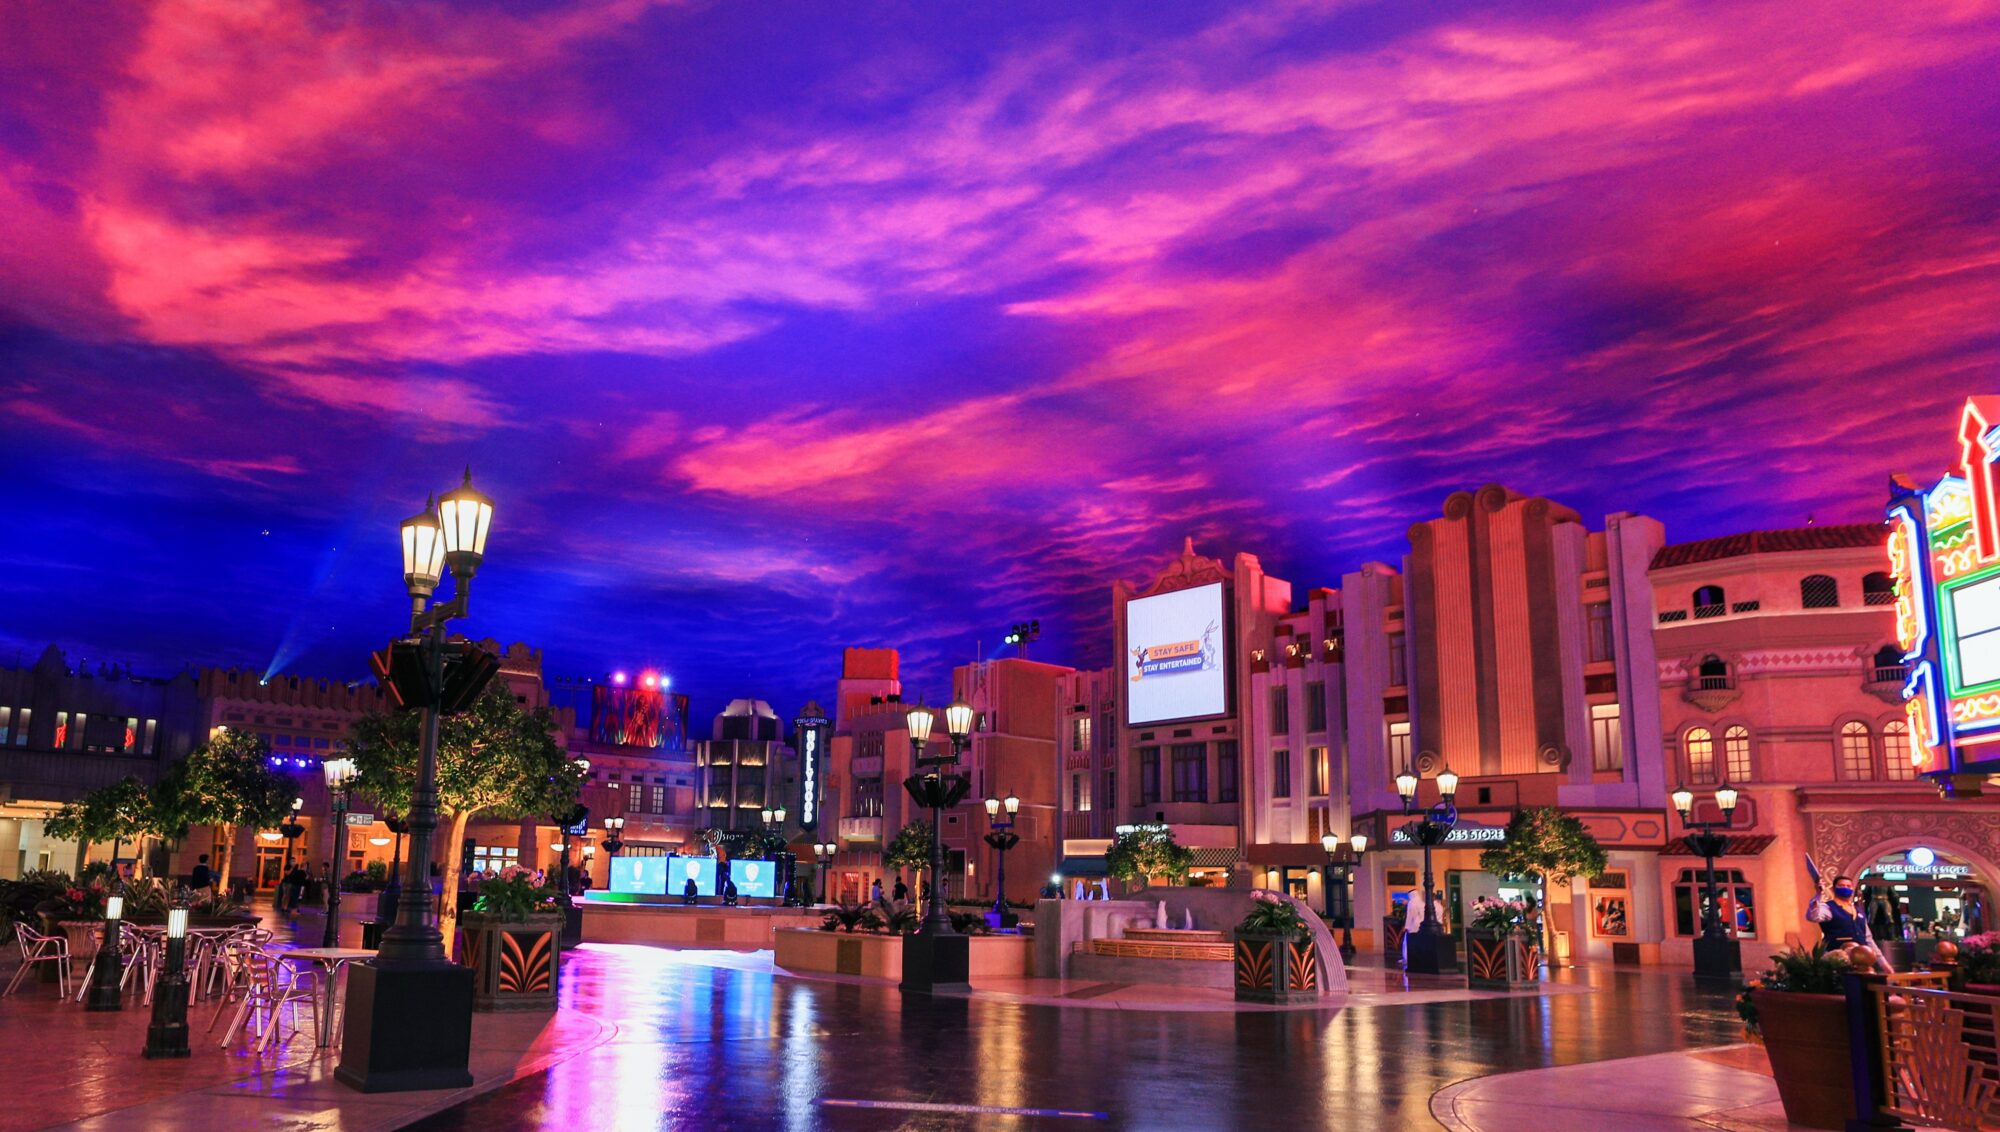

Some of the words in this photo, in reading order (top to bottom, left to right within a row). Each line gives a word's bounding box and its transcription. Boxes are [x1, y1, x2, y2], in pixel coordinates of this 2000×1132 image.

[1154, 648, 1172, 656] STAY
[1174, 643, 1194, 653] SAFE
[1144, 664, 1159, 672] STAY
[1160, 657, 1201, 670] ENTERTAINED
[803, 729, 816, 823] HOLLYWOOD
[1471, 828, 1505, 841] STORE
